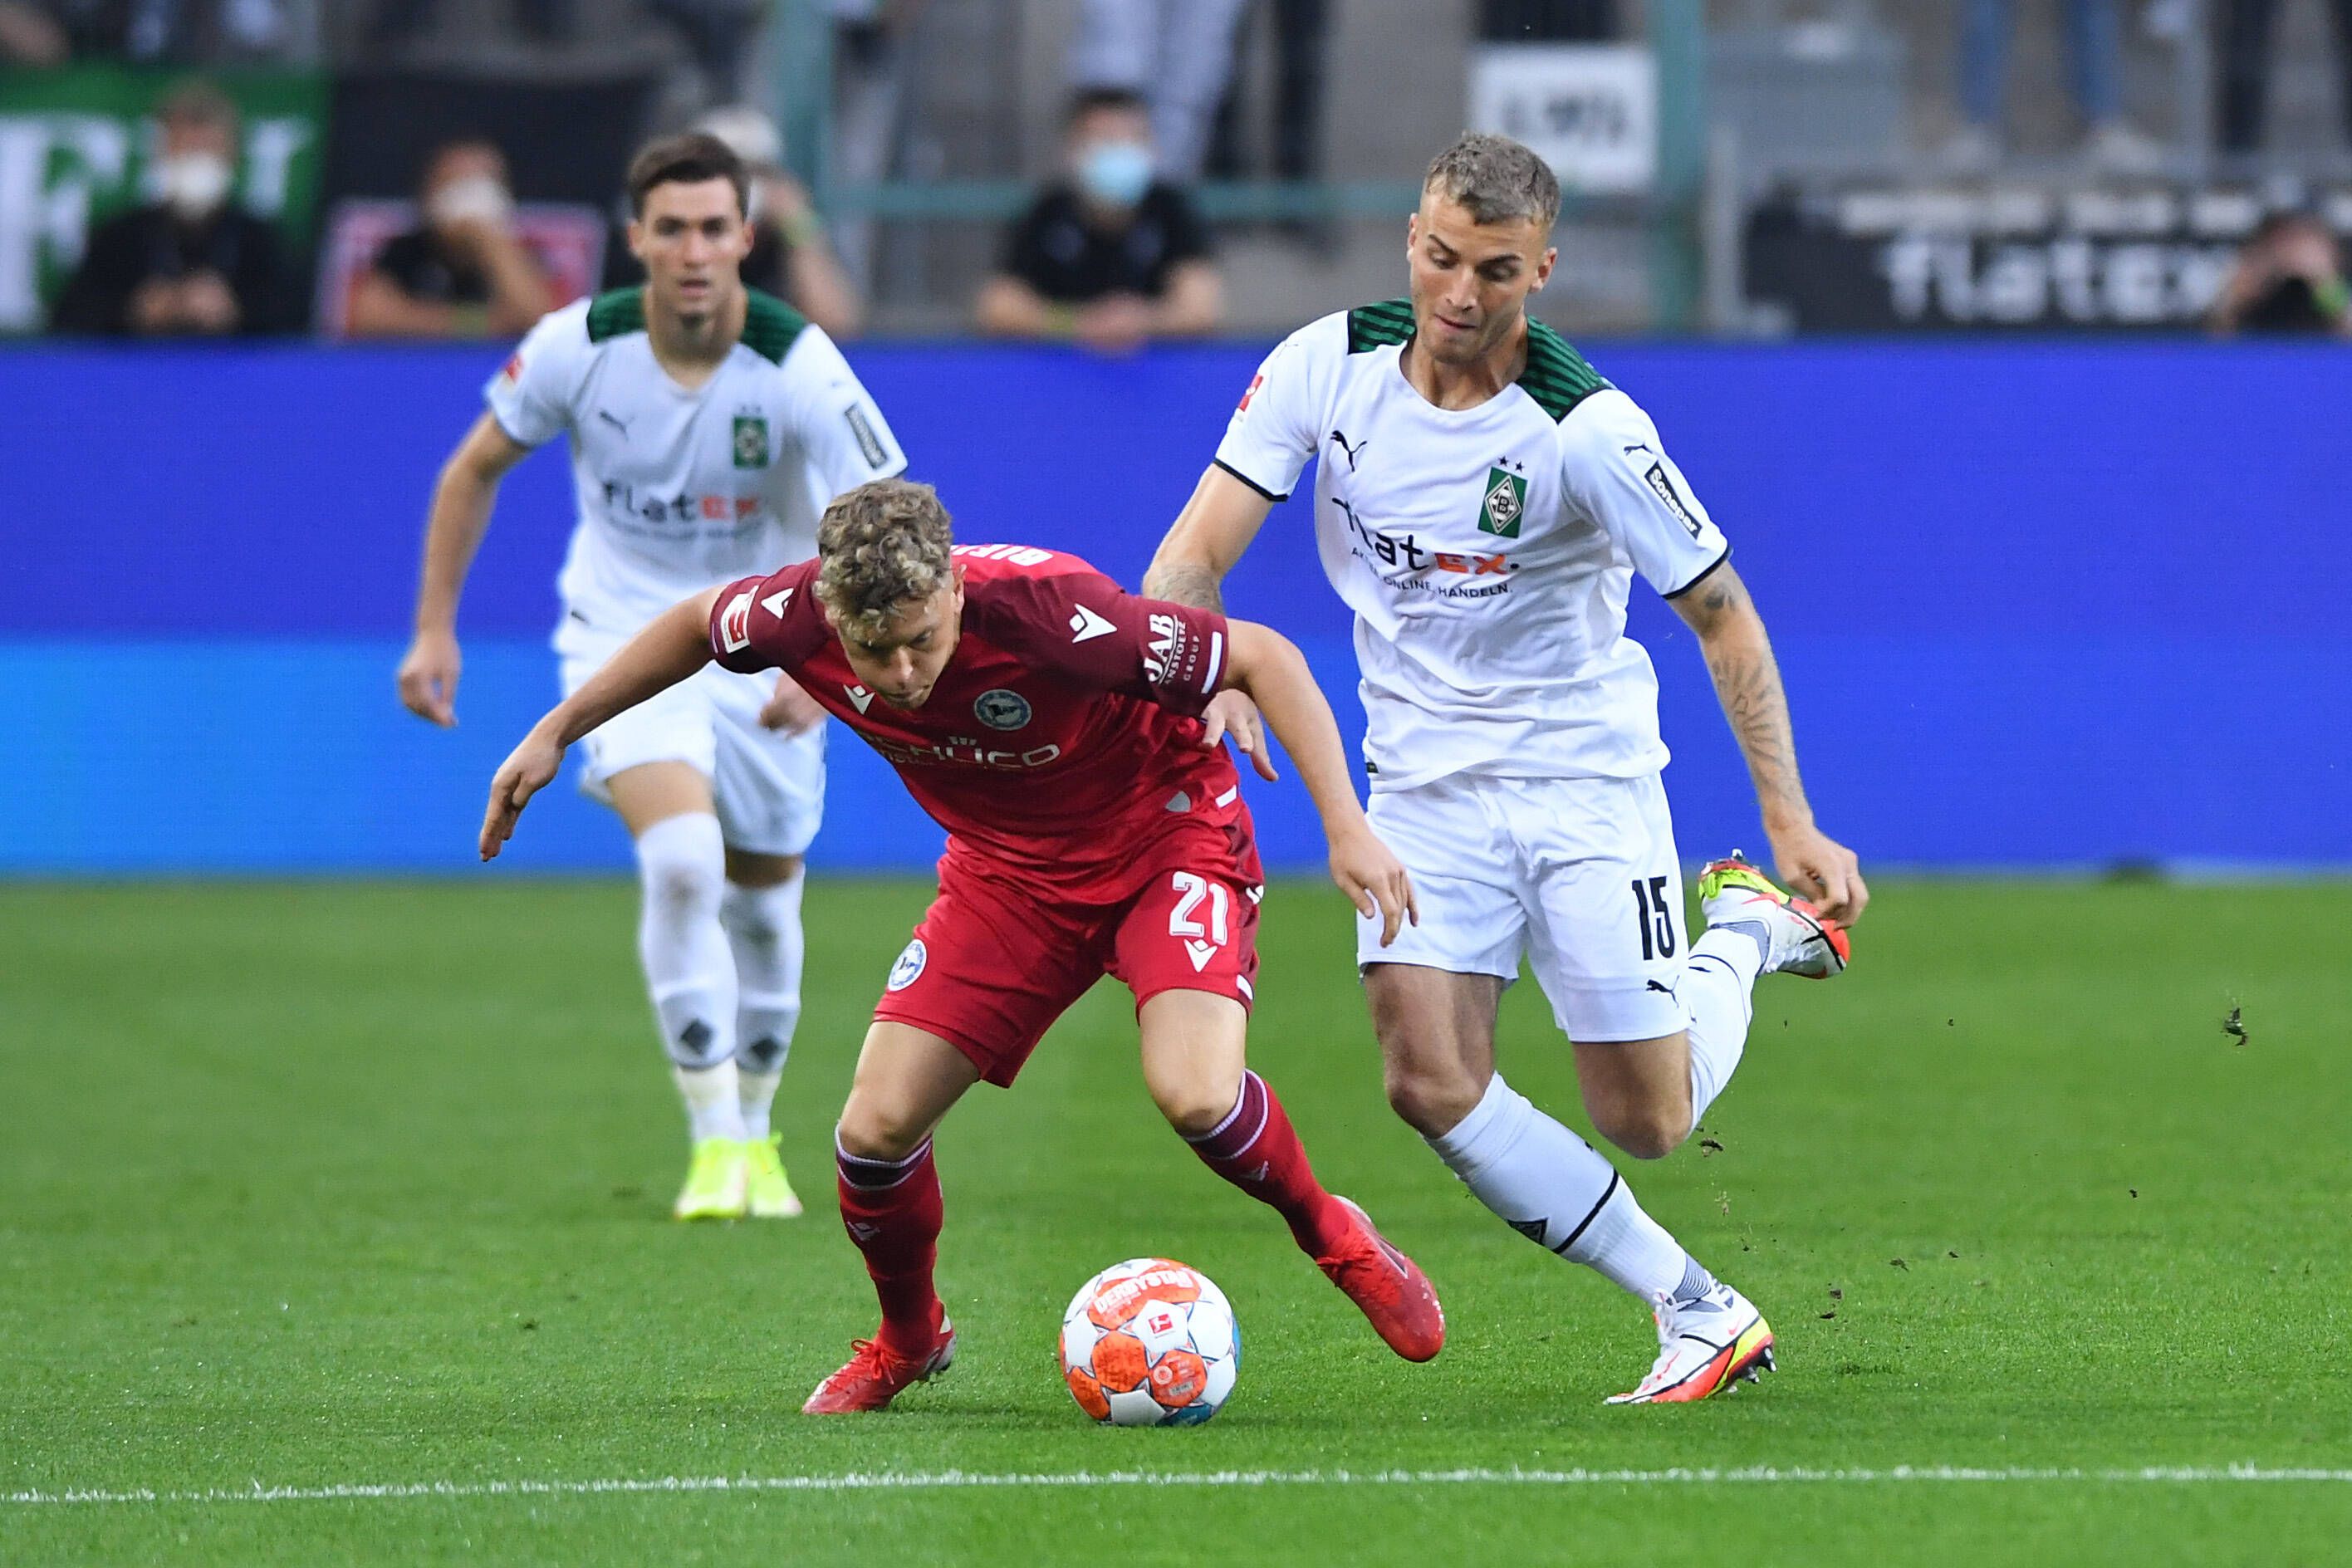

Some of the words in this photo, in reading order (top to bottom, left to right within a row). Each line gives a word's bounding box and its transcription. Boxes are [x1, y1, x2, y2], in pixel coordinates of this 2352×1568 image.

[1143, 614, 1175, 682] JAB
[1183, 635, 1200, 681] GROUP
[1169, 871, 1229, 947] 21
[1631, 875, 1675, 961] 15
